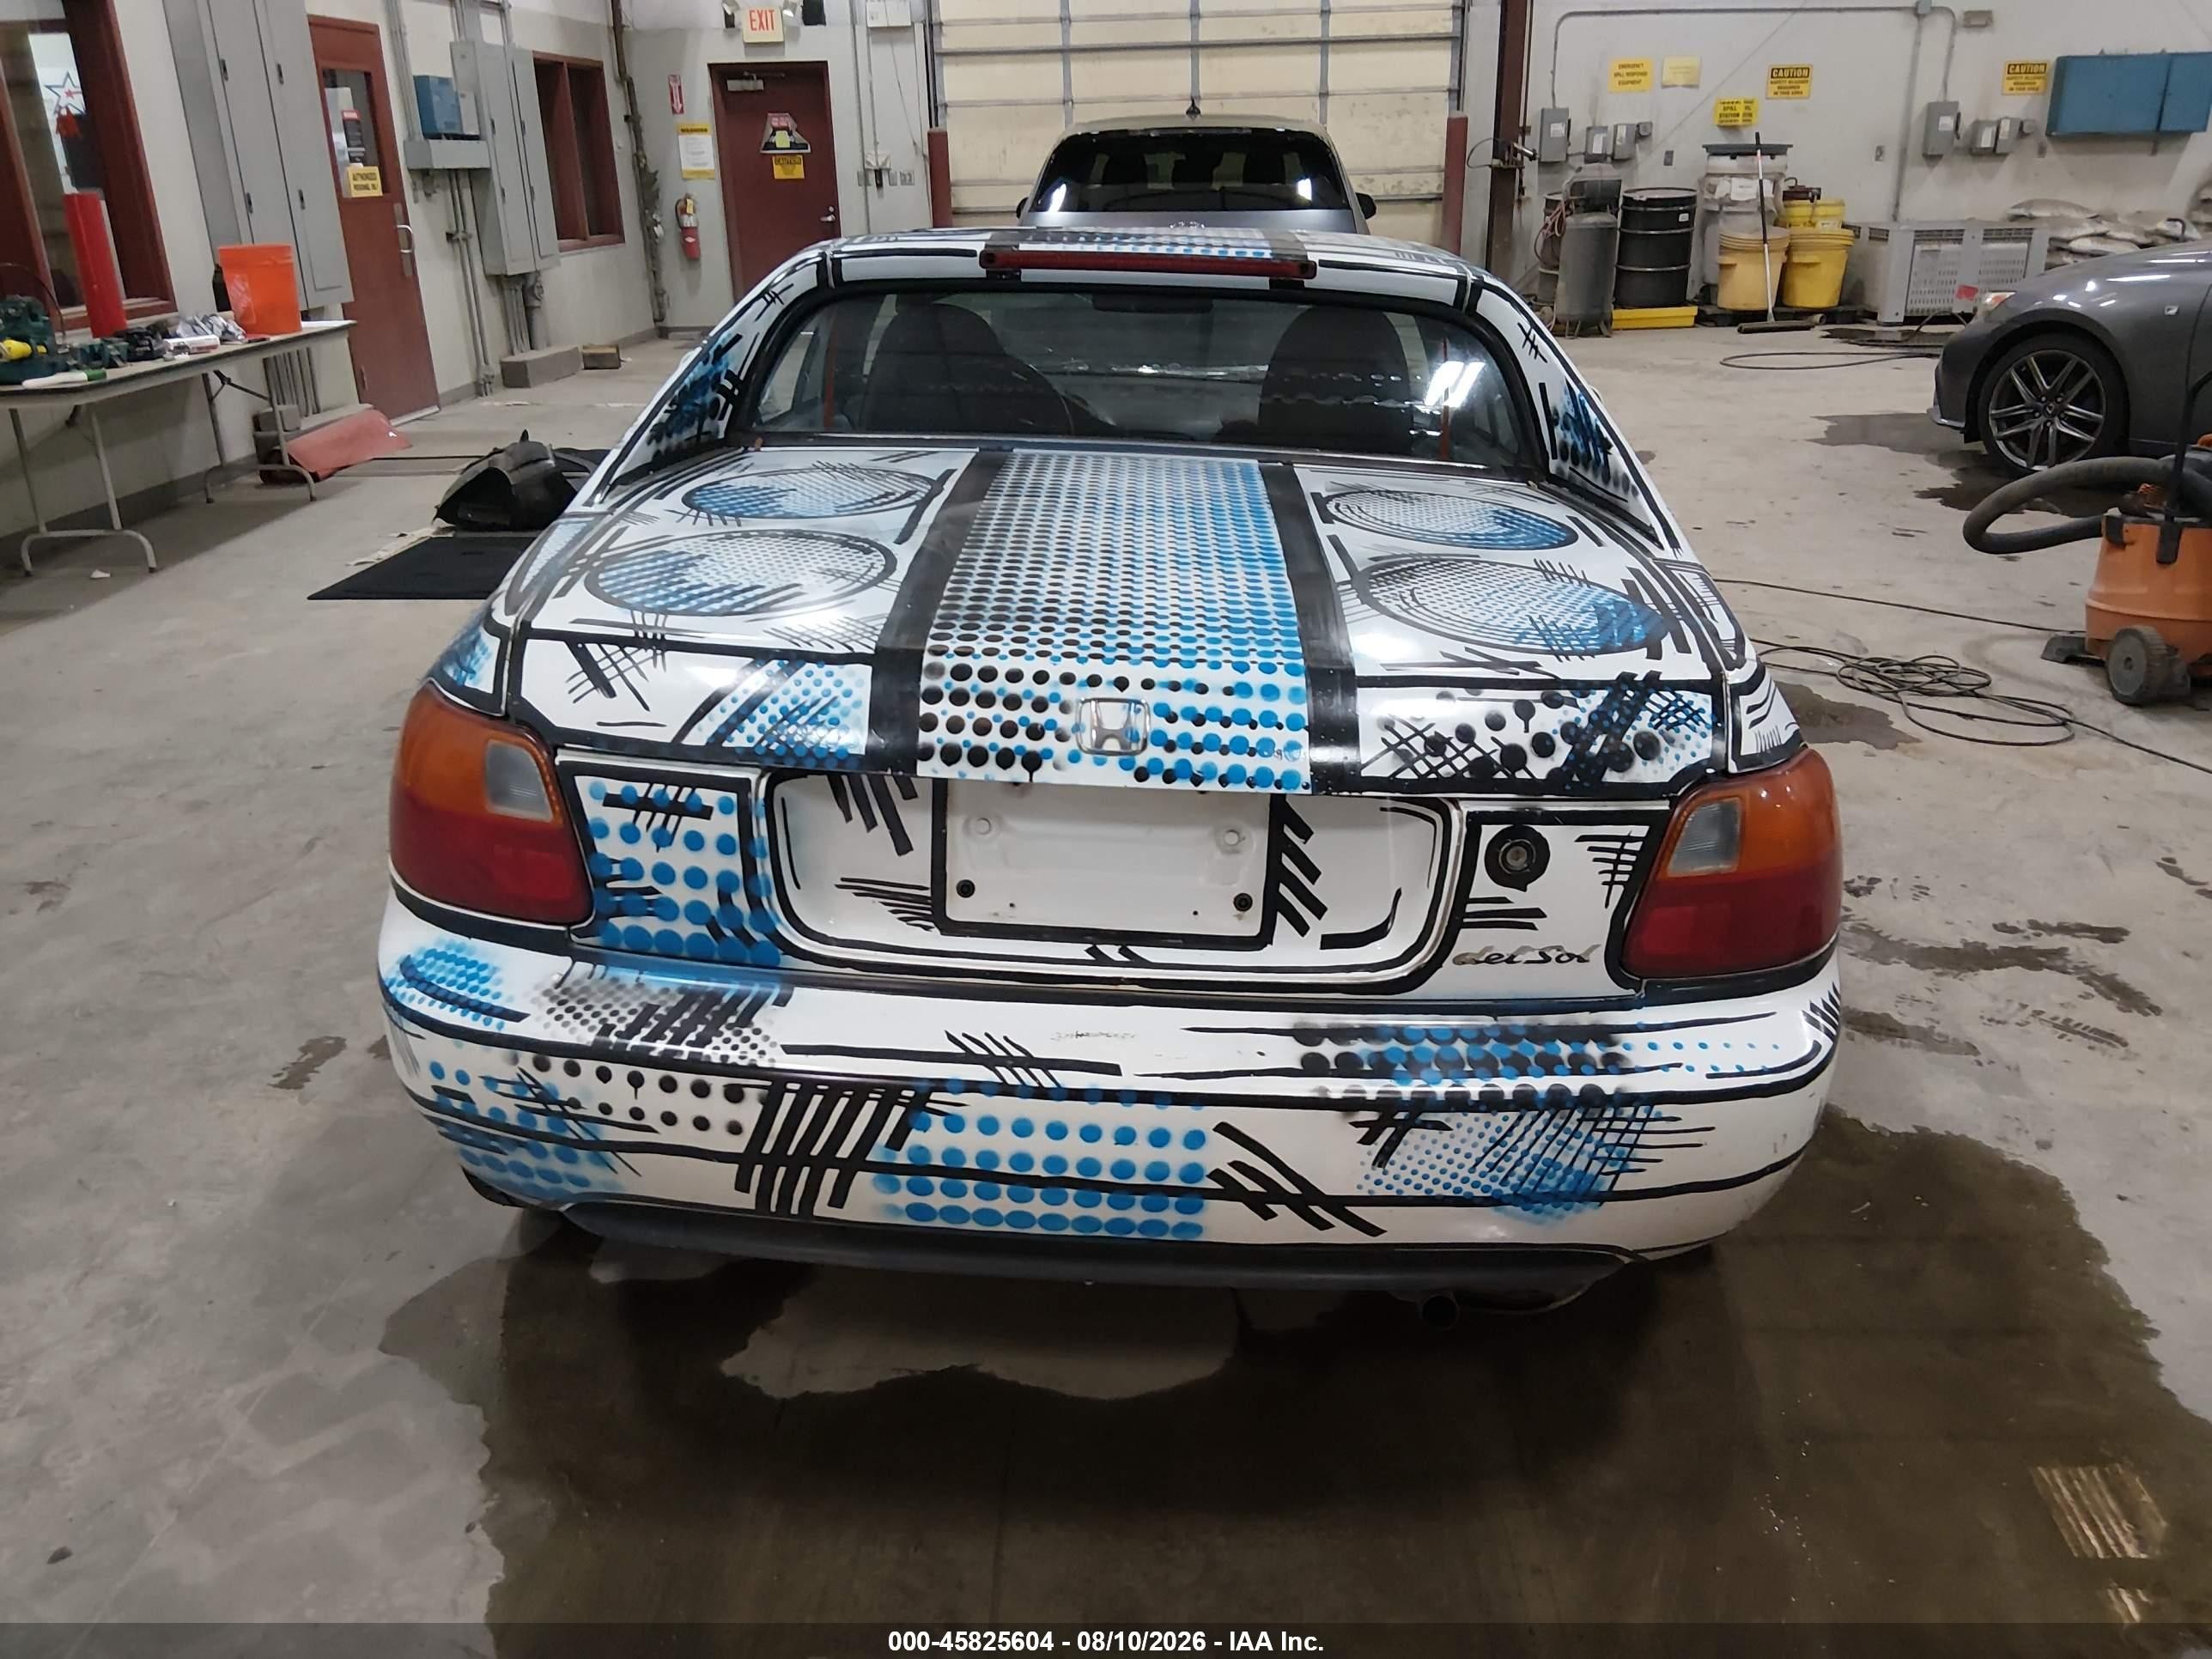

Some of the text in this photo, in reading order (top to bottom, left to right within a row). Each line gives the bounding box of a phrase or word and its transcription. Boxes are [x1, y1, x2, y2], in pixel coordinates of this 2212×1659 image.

[749, 9, 775, 31] EXIT
[1772, 68, 1808, 77] CAUTION
[2008, 64, 2046, 74] CAUTION
